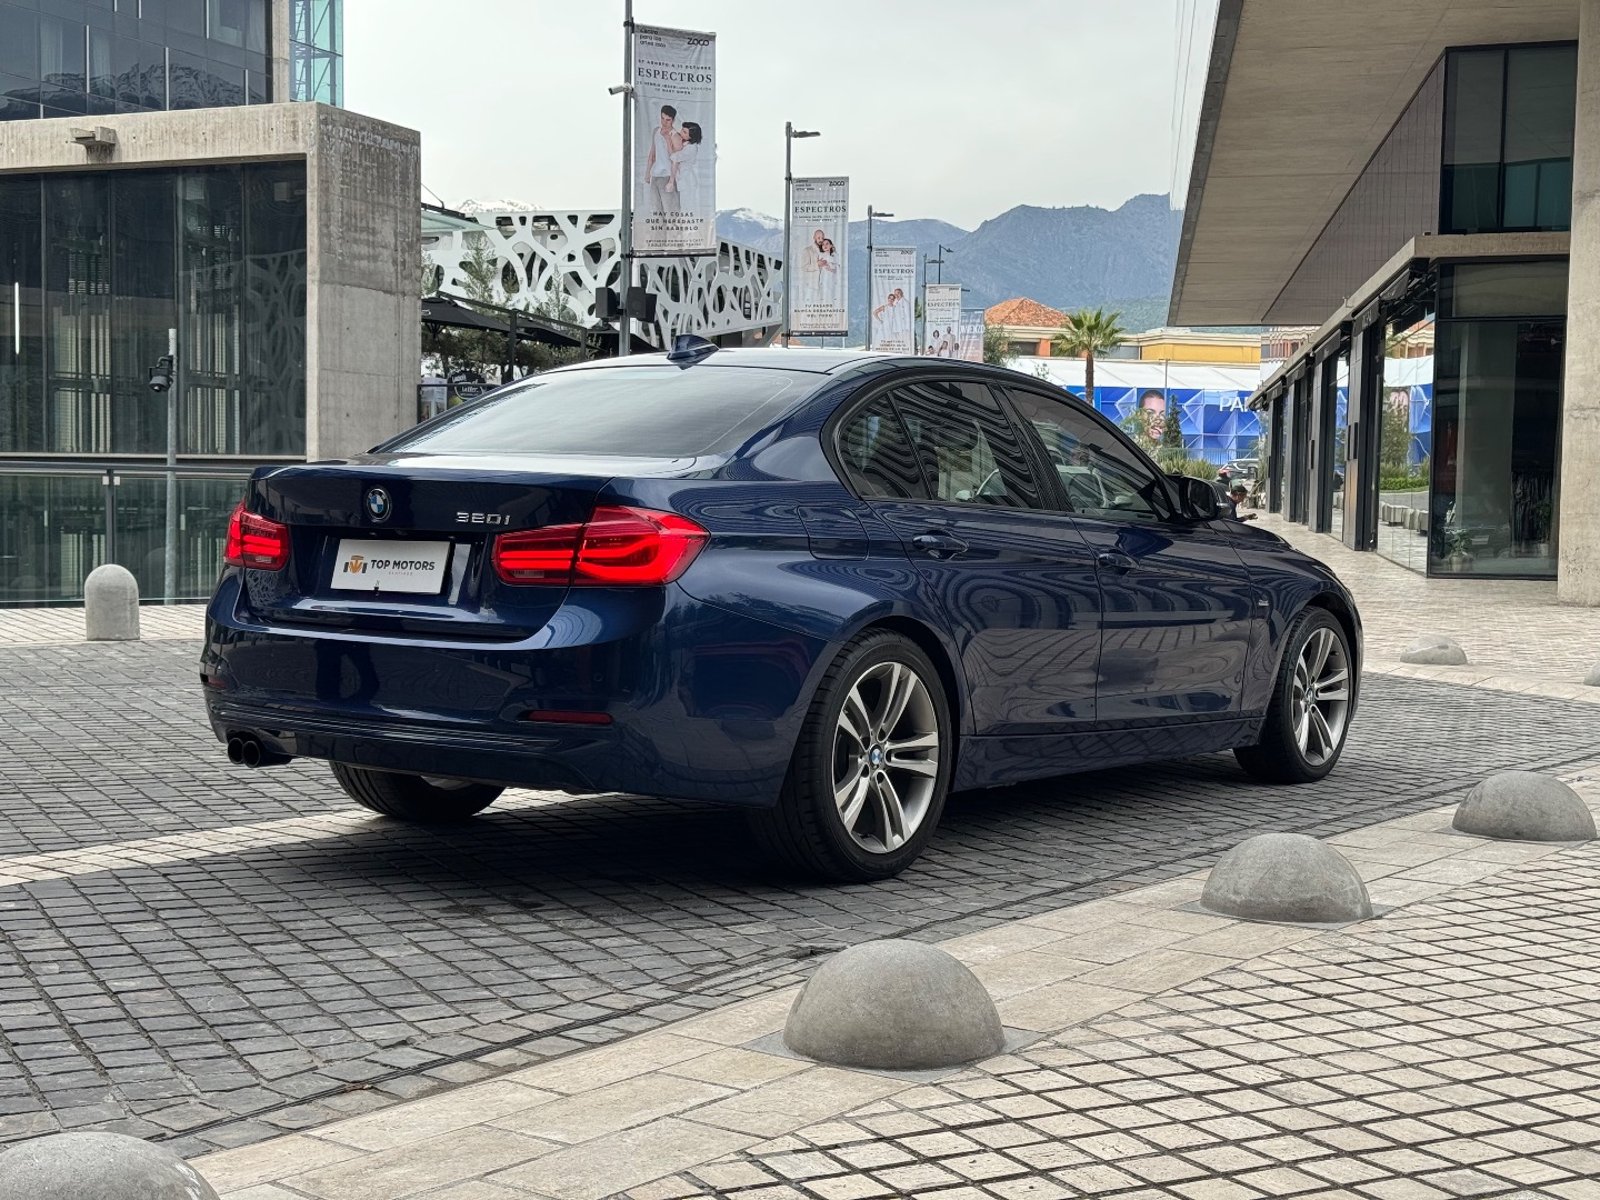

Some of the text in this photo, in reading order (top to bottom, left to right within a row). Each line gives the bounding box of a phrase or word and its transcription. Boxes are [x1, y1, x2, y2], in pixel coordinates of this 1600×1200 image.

[638, 67, 712, 84] ESPECTROS
[370, 559, 435, 570] TOP MOTORS
